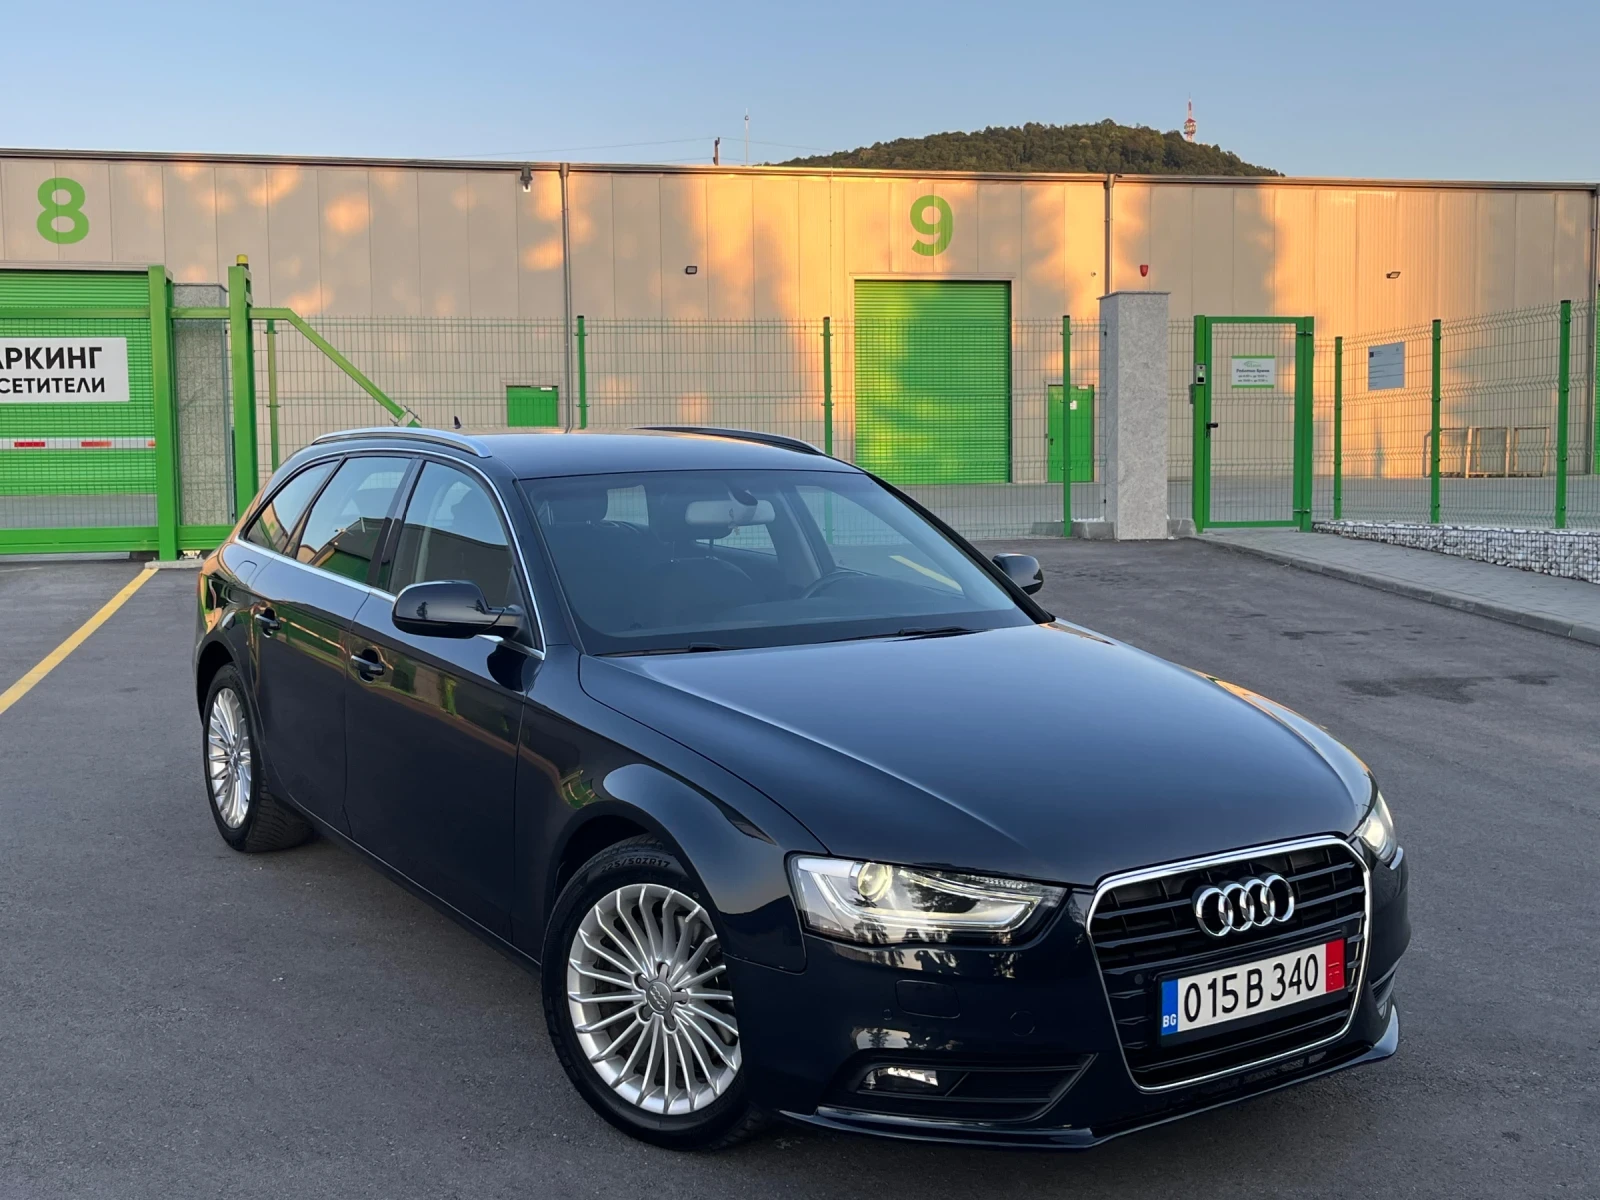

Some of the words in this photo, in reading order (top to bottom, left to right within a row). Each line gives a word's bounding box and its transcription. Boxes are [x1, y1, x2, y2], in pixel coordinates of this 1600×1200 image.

[37, 177, 90, 244] 8
[909, 194, 953, 256] 9
[0, 347, 102, 369] РКИНГ
[1162, 1013, 1177, 1028] BG
